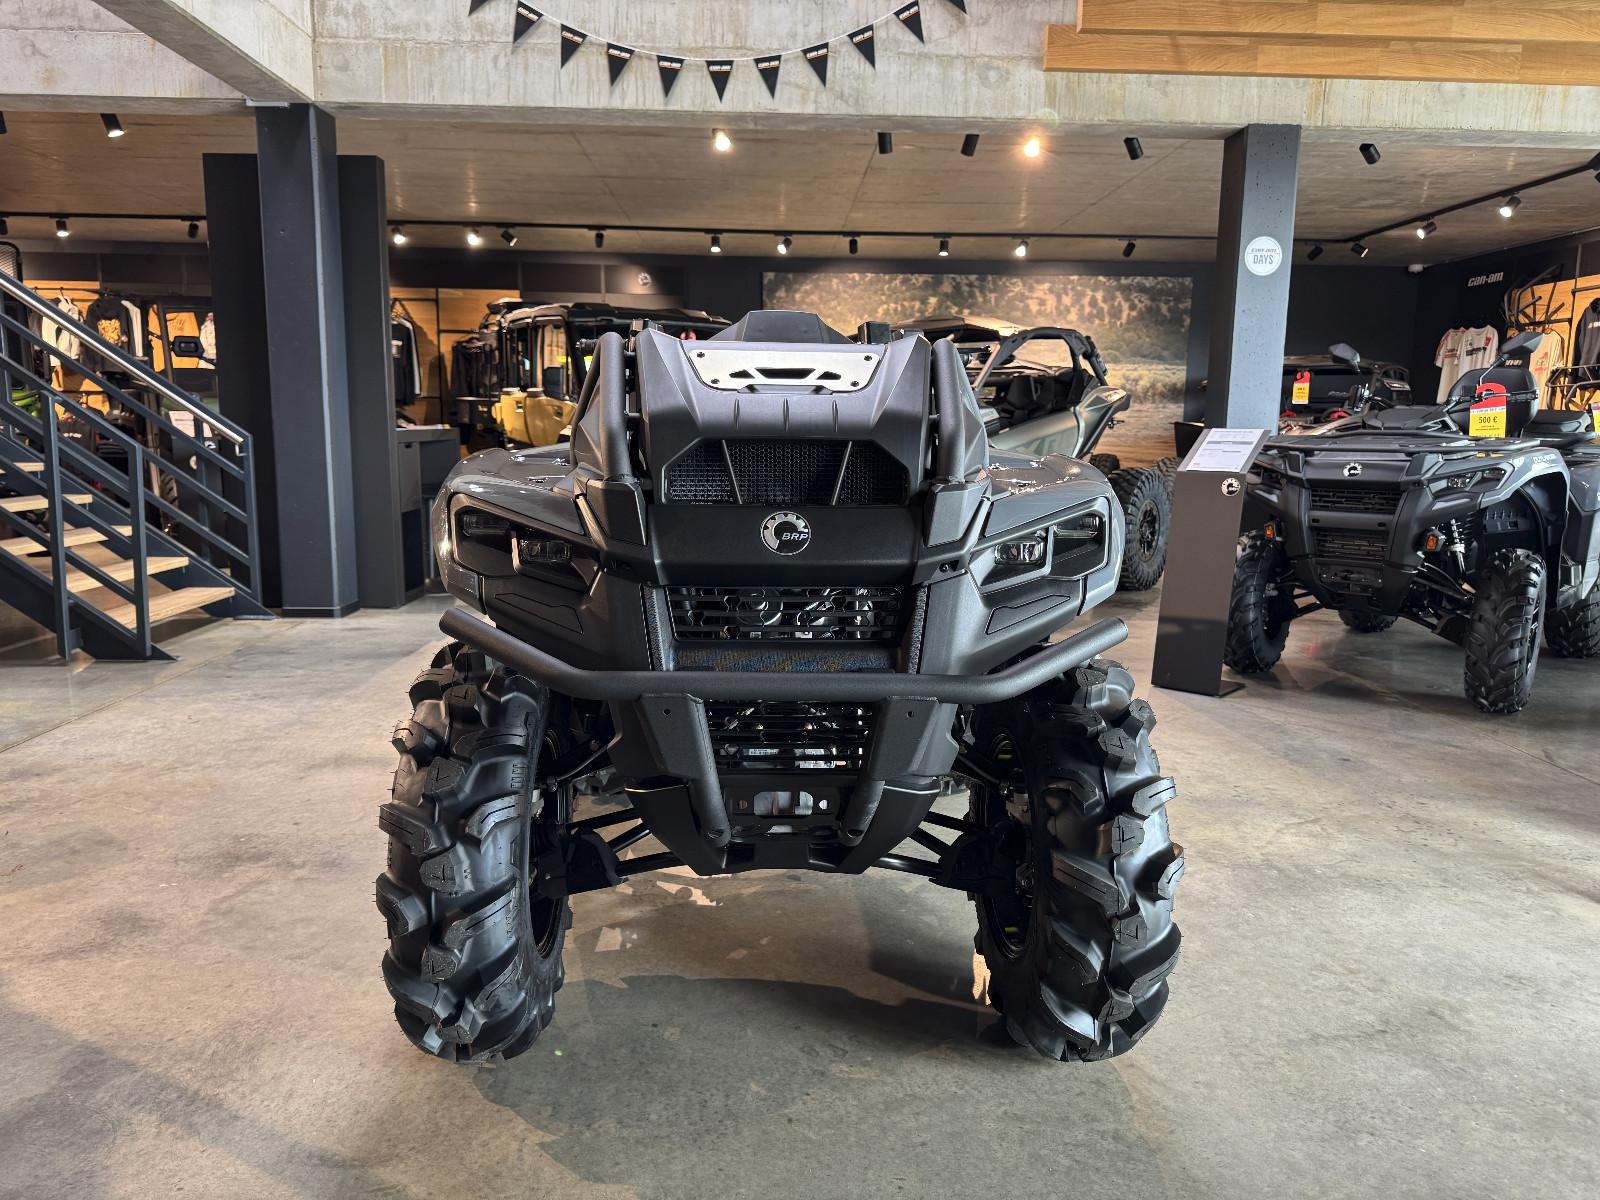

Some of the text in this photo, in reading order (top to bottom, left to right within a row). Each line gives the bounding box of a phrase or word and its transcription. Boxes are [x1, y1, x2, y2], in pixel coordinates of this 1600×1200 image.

[1253, 254, 1274, 265] DAYS
[1467, 271, 1504, 287] can-am
[781, 532, 809, 541] BRP
